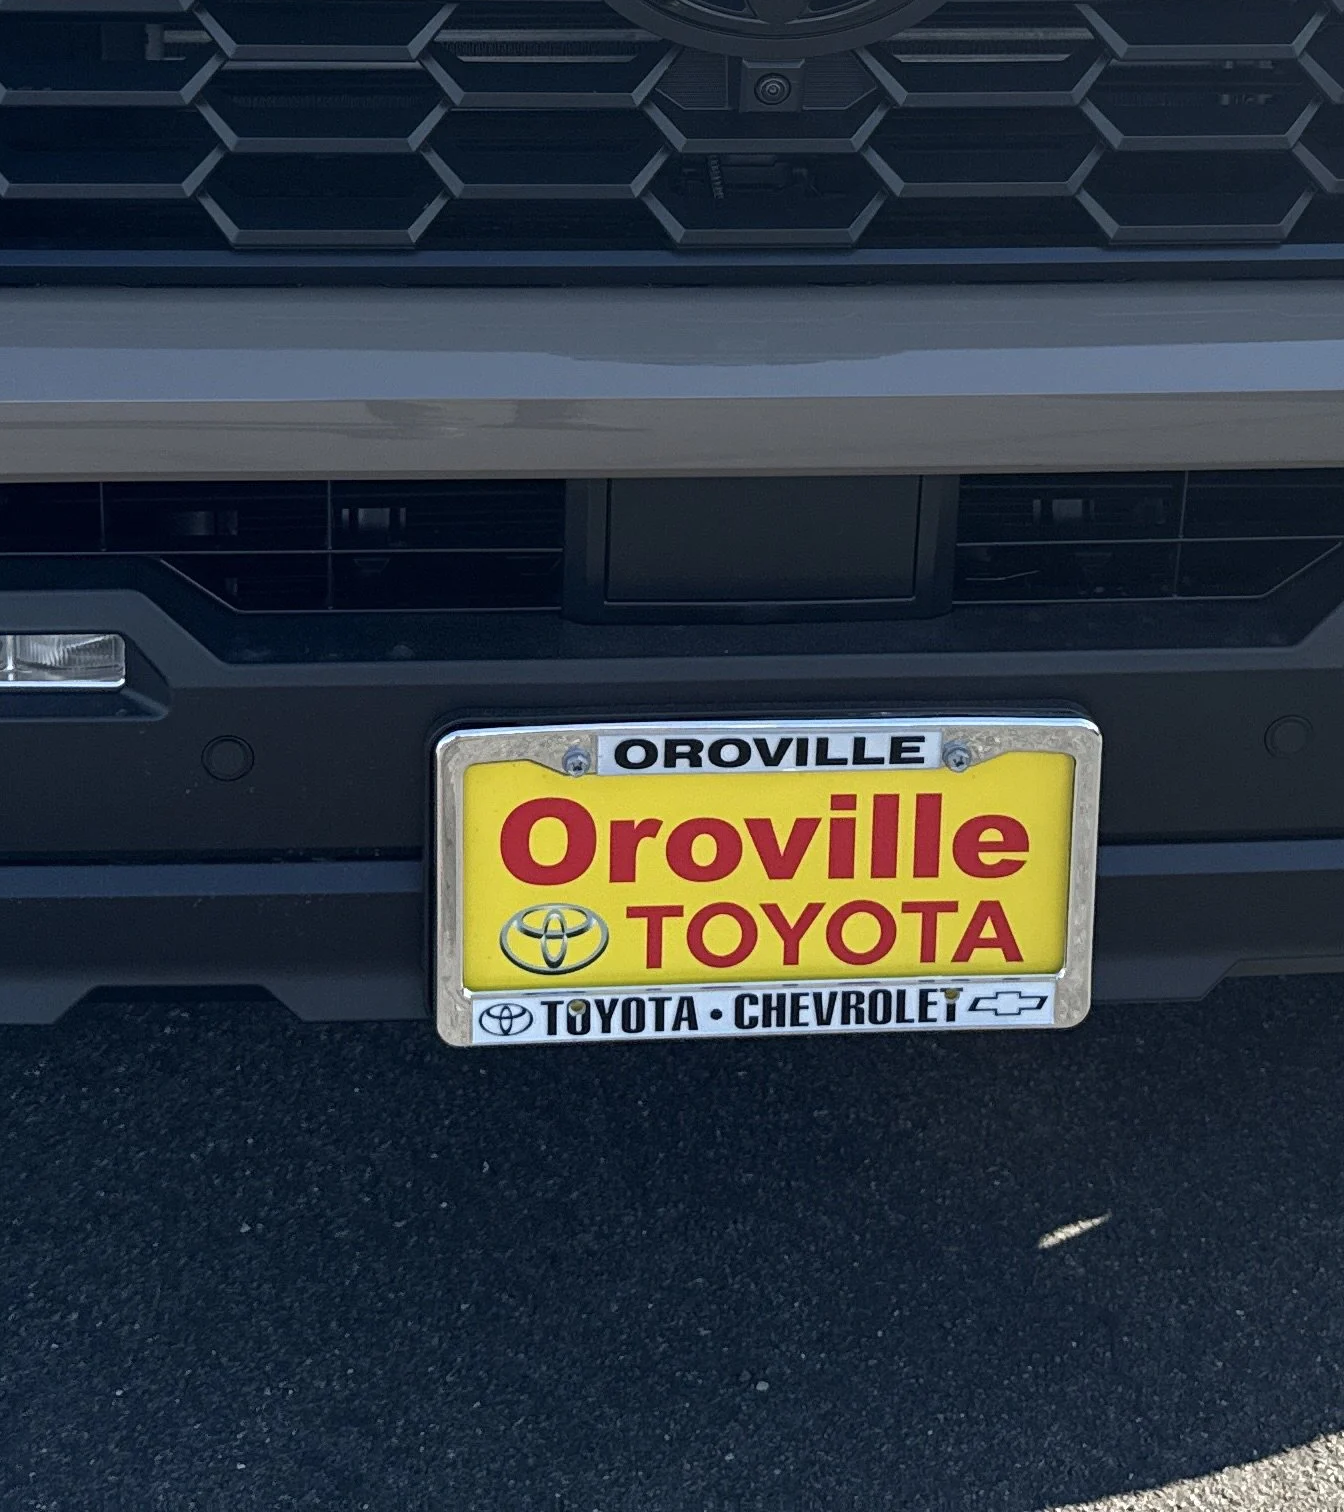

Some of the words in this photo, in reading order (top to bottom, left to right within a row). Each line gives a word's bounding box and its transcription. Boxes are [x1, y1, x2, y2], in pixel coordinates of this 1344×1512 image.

[614, 736, 926, 770] OROVILLE
[499, 793, 1030, 886] Oroville
[626, 900, 1024, 970] TOYOTA
[541, 997, 699, 1036] TOYOTA
[734, 988, 963, 1030] CHEVROLET
